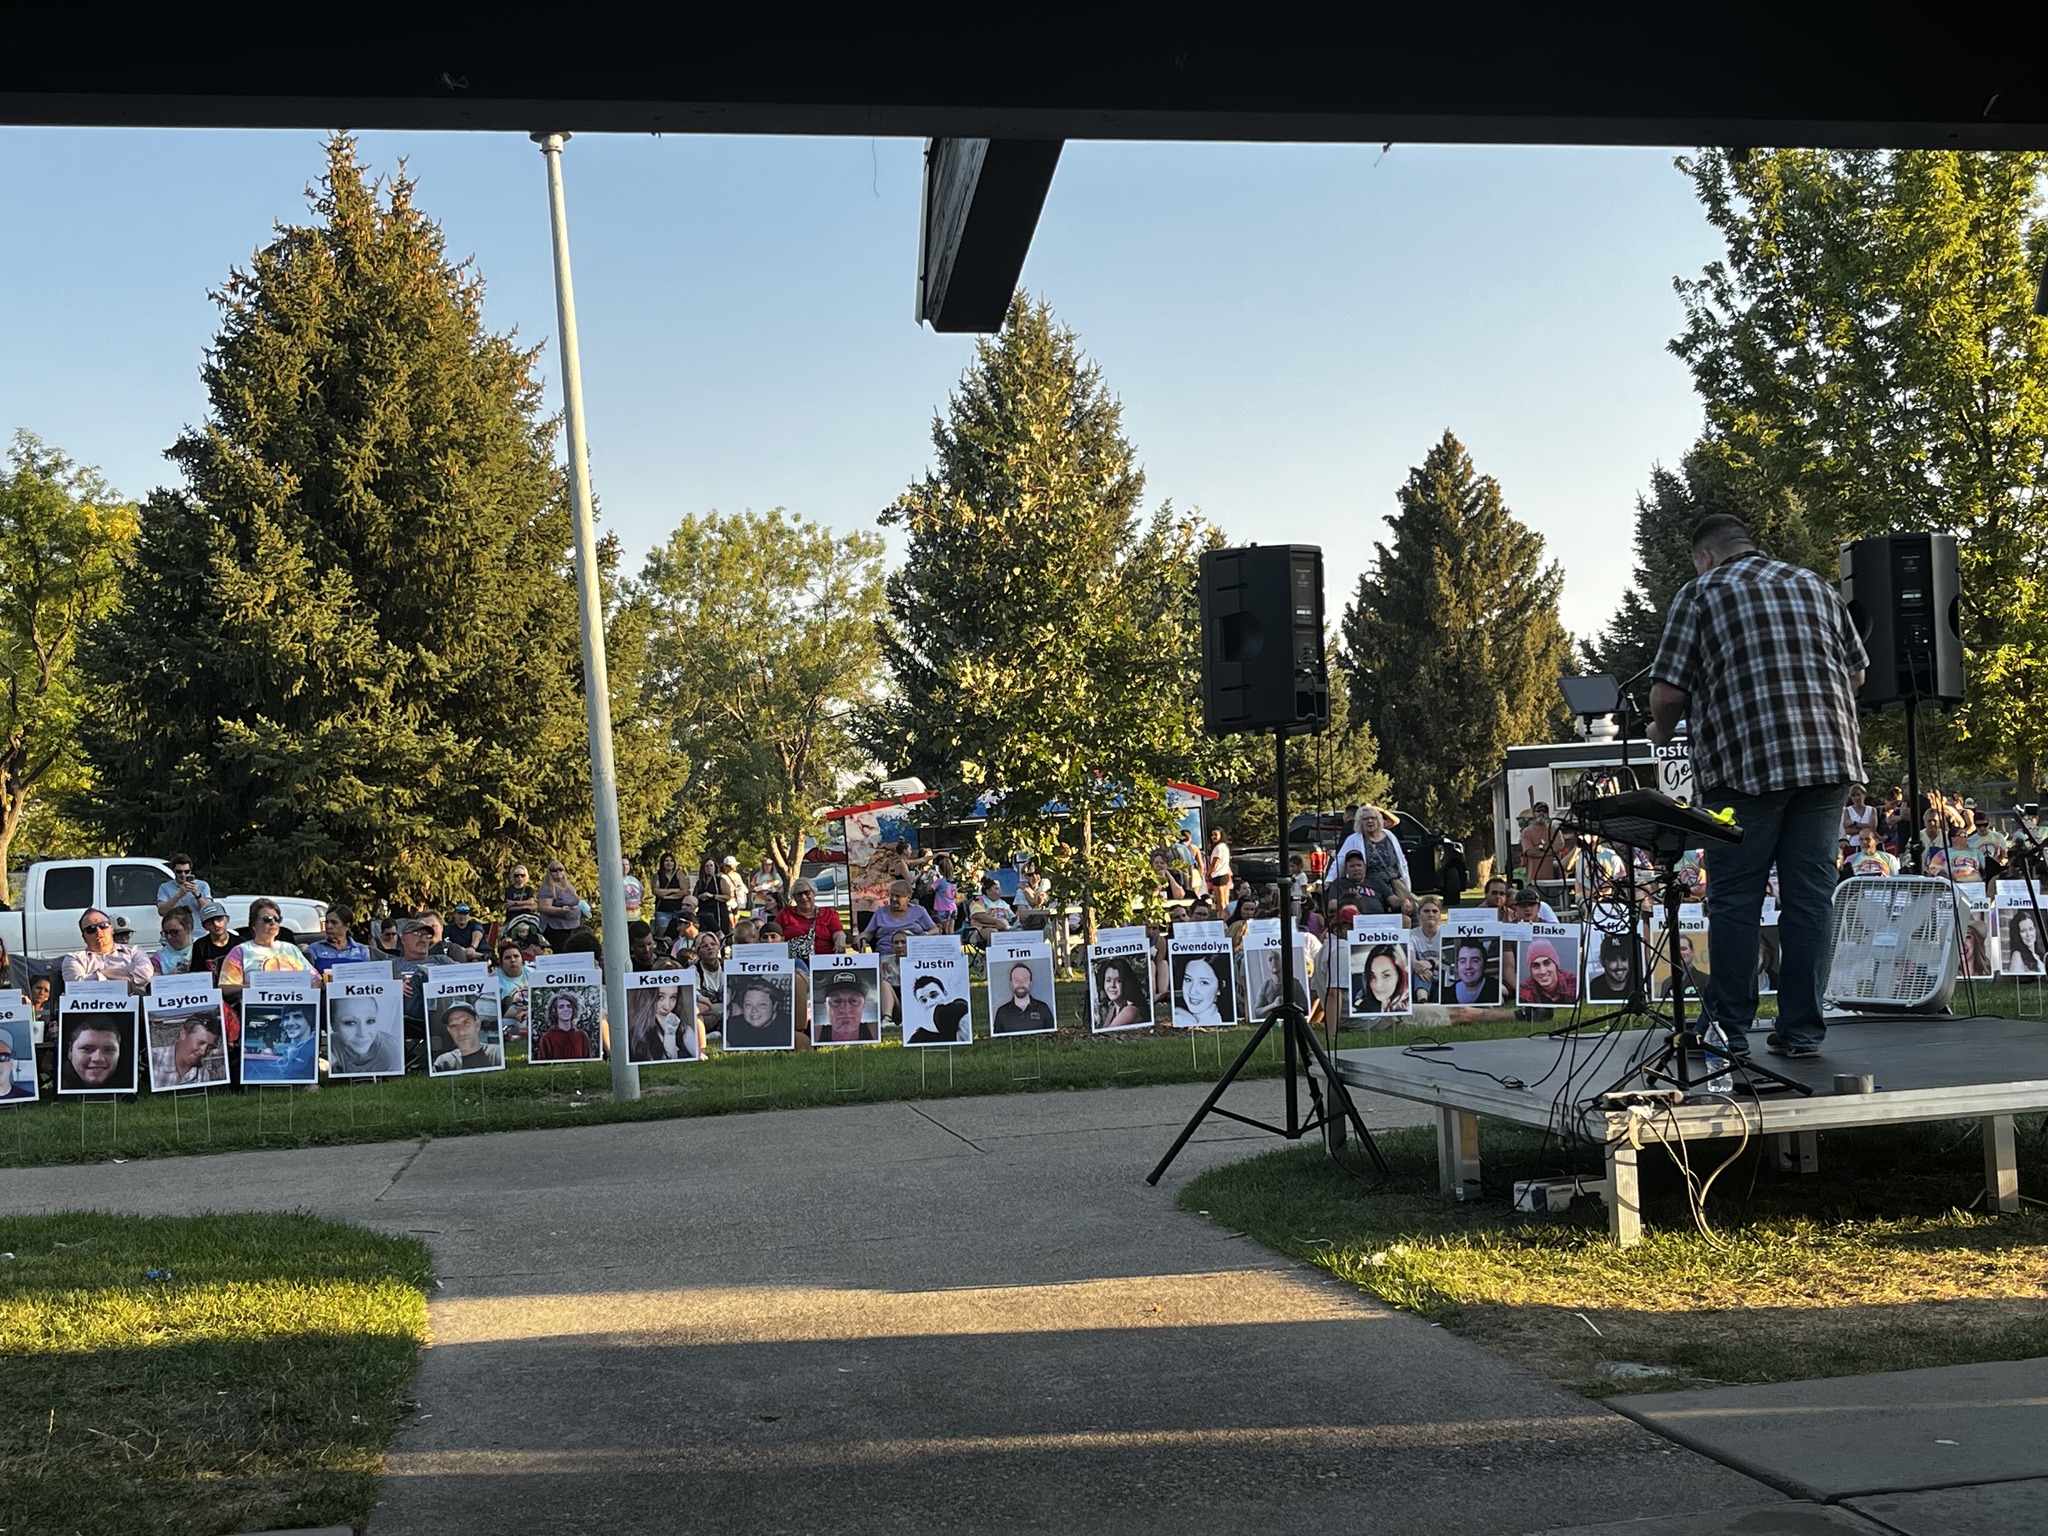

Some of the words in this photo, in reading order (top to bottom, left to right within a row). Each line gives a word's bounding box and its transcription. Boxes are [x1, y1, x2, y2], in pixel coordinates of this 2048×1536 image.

[2007, 897, 2033, 907] Jaim
[1533, 926, 1566, 935] Blake
[1658, 921, 1704, 930] Mhael
[1457, 925, 1485, 937] Kyle
[1359, 932, 1399, 942] Debbie
[1094, 942, 1143, 956] Breanna
[1171, 942, 1229, 953] Gwendolyn
[1007, 949, 1031, 958] Tim
[739, 962, 780, 972] Terrie
[832, 957, 857, 967] J.D.
[914, 959, 954, 970] Justin
[546, 975, 586, 984] Collin
[639, 975, 681, 985] Katee
[345, 985, 384, 996] Katie
[437, 983, 485, 995] Jamey
[158, 994, 208, 1008] Layton
[259, 991, 303, 1001] Travis
[70, 1000, 127, 1010] Andrew
